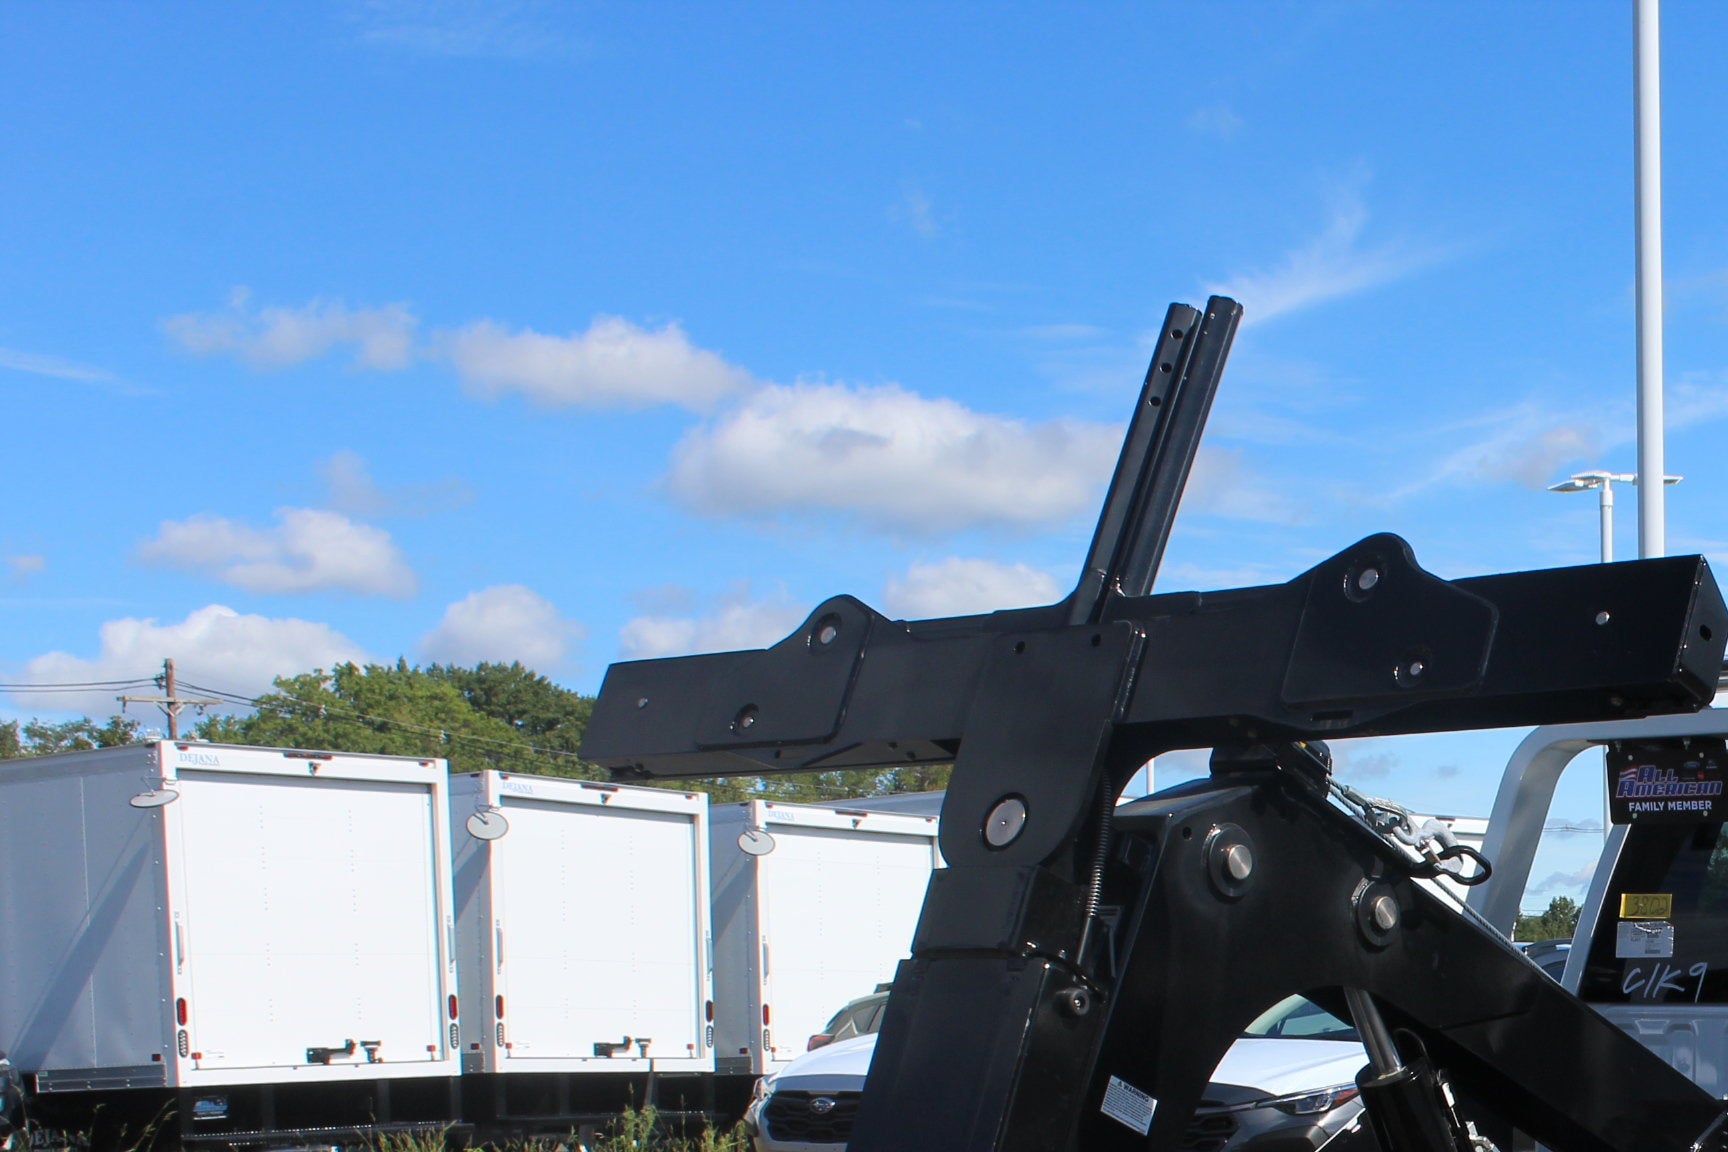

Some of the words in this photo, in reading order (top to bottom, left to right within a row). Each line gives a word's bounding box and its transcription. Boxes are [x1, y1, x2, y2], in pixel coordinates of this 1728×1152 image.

[179, 753, 220, 765] DEJANA
[1629, 802, 1665, 812] FAMILY
[1668, 801, 1712, 811] MEMBER
[1123, 1083, 1149, 1102] WARNING
